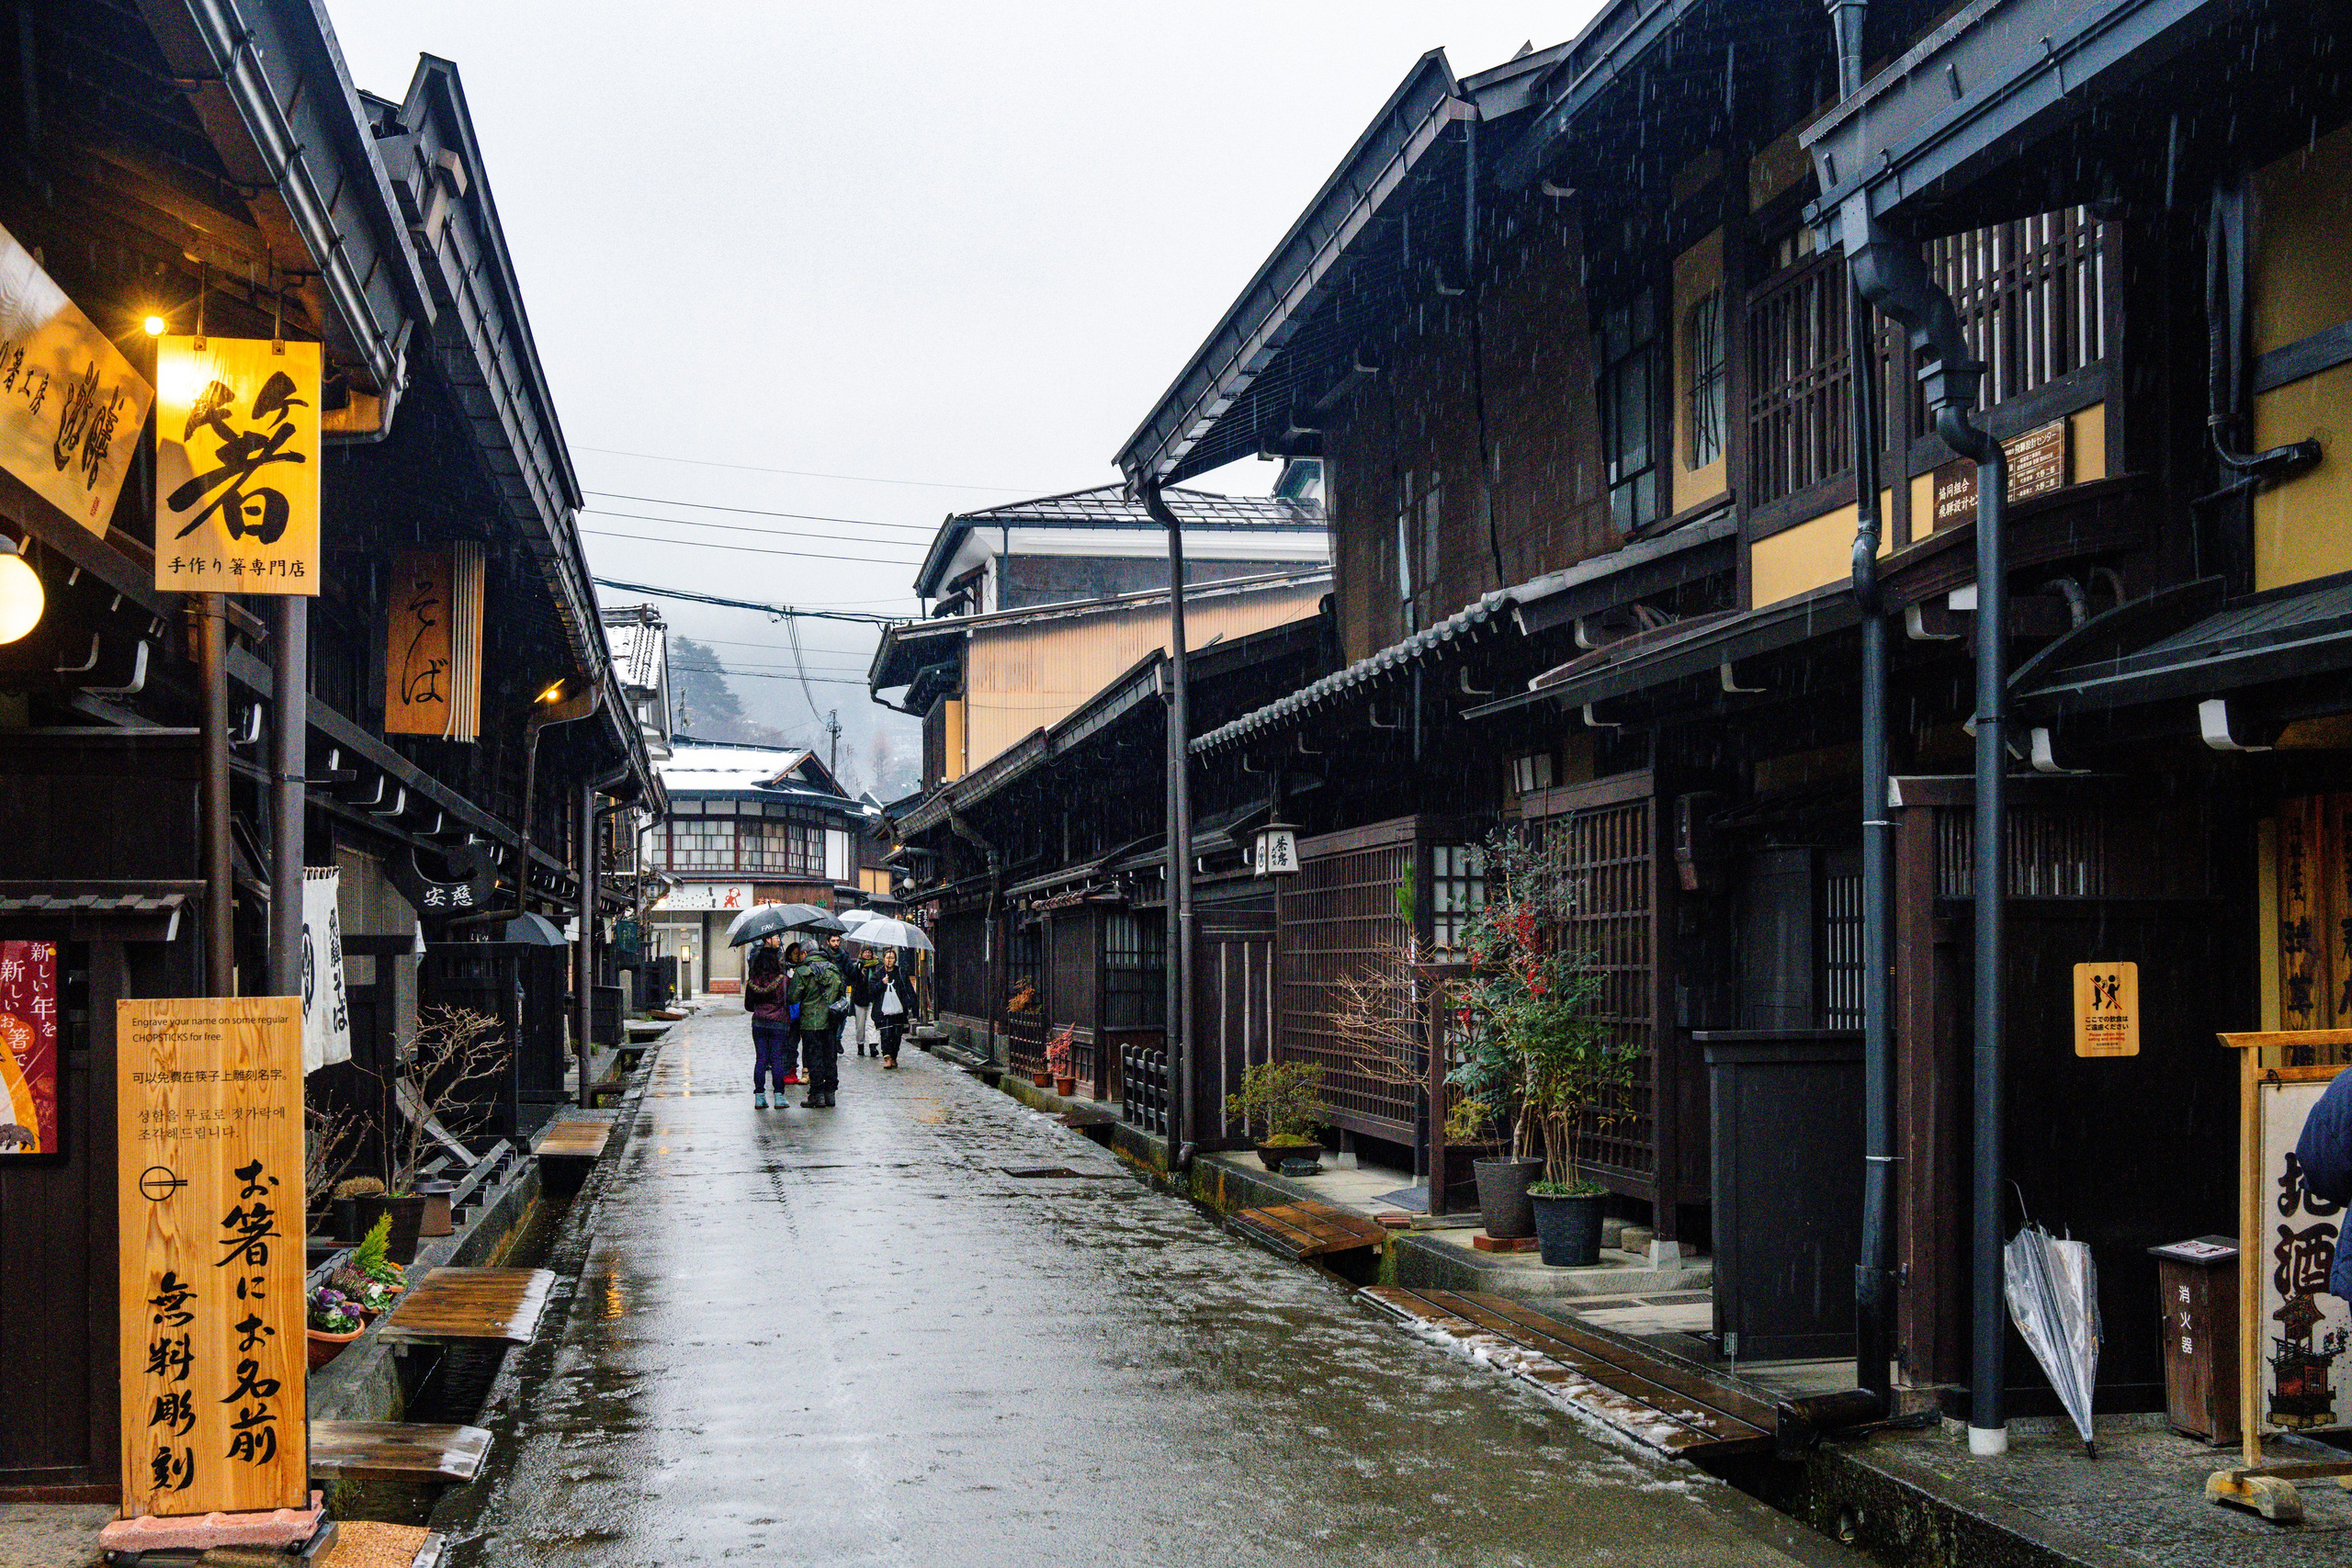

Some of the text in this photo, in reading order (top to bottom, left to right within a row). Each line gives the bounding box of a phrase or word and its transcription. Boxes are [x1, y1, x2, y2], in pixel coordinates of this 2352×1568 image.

[166, 370, 309, 546] 箸
[1939, 478, 1971, 502] 協同組合
[168, 557, 305, 577] 手作り箸専門店
[401, 581, 448, 705] そば
[1, 959, 29, 1066] 新しいお箸で
[30, 942, 57, 1037] 新しい年を
[132, 1018, 167, 1028] Engrave
[170, 1019, 189, 1027] your
[258, 1015, 288, 1026] regular
[133, 1032, 223, 1042] CHOPSTICKS for free.
[133, 1069, 287, 1084] 可以免費在筷子上雕刻名字。
[138, 1107, 285, 1123] 성함을 무료로 젓가락에
[139, 1126, 239, 1141] 조각해드립니다.
[212, 1159, 281, 1467] お箸にお名前
[2178, 1285, 2193, 1354] 消火器
[144, 1270, 198, 1493] 無料彫刻
